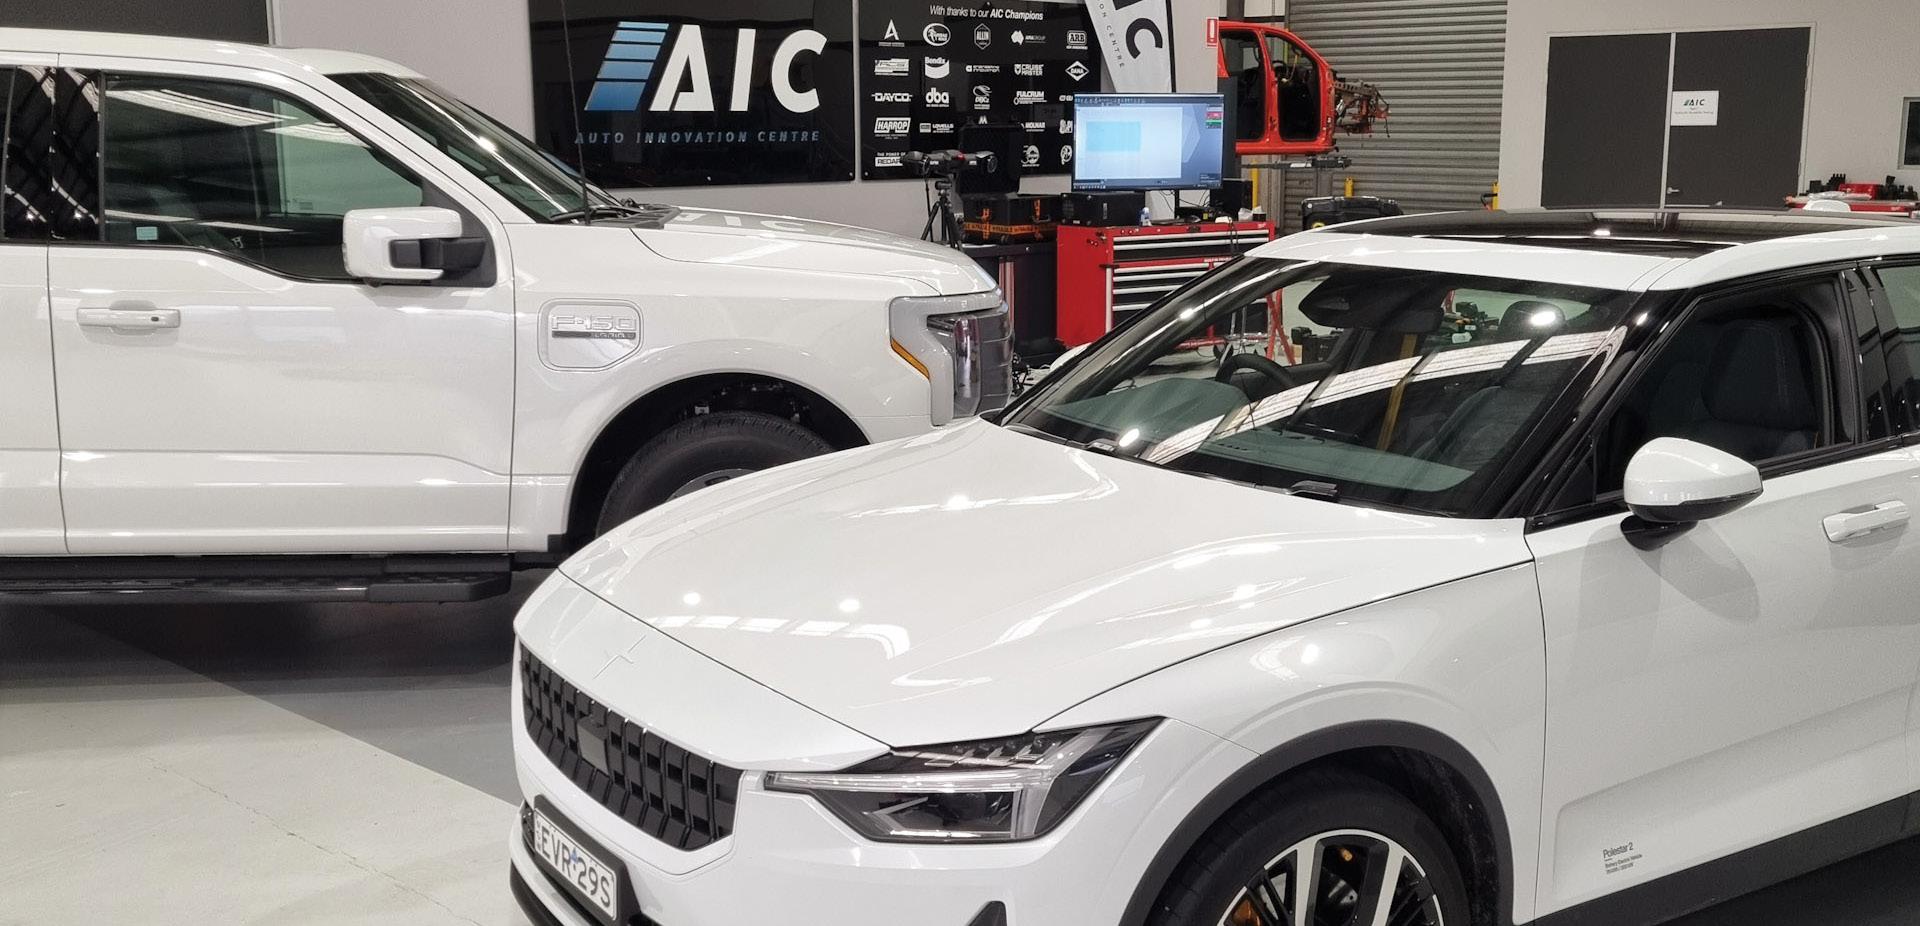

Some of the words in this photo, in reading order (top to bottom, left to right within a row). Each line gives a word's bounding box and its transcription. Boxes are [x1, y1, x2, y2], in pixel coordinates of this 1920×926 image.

[929, 5, 945, 16] With
[946, 6, 968, 17] thanks
[969, 8, 977, 17] to
[978, 9, 990, 18] our
[990, 8, 1004, 19] AIC
[1004, 9, 1044, 21] Champions
[1069, 33, 1085, 42] ARB
[1106, 25, 1125, 68] CENTRE
[648, 23, 828, 114] AIC
[872, 92, 913, 102] DAYCO
[925, 87, 950, 104] dba
[1016, 90, 1045, 98] FULCRUM
[877, 121, 908, 130] HARROP
[574, 131, 625, 145] AUTO
[636, 130, 748, 144] INNOVATION
[757, 129, 820, 143] CENTRE
[1629, 842, 1634, 850] 2
